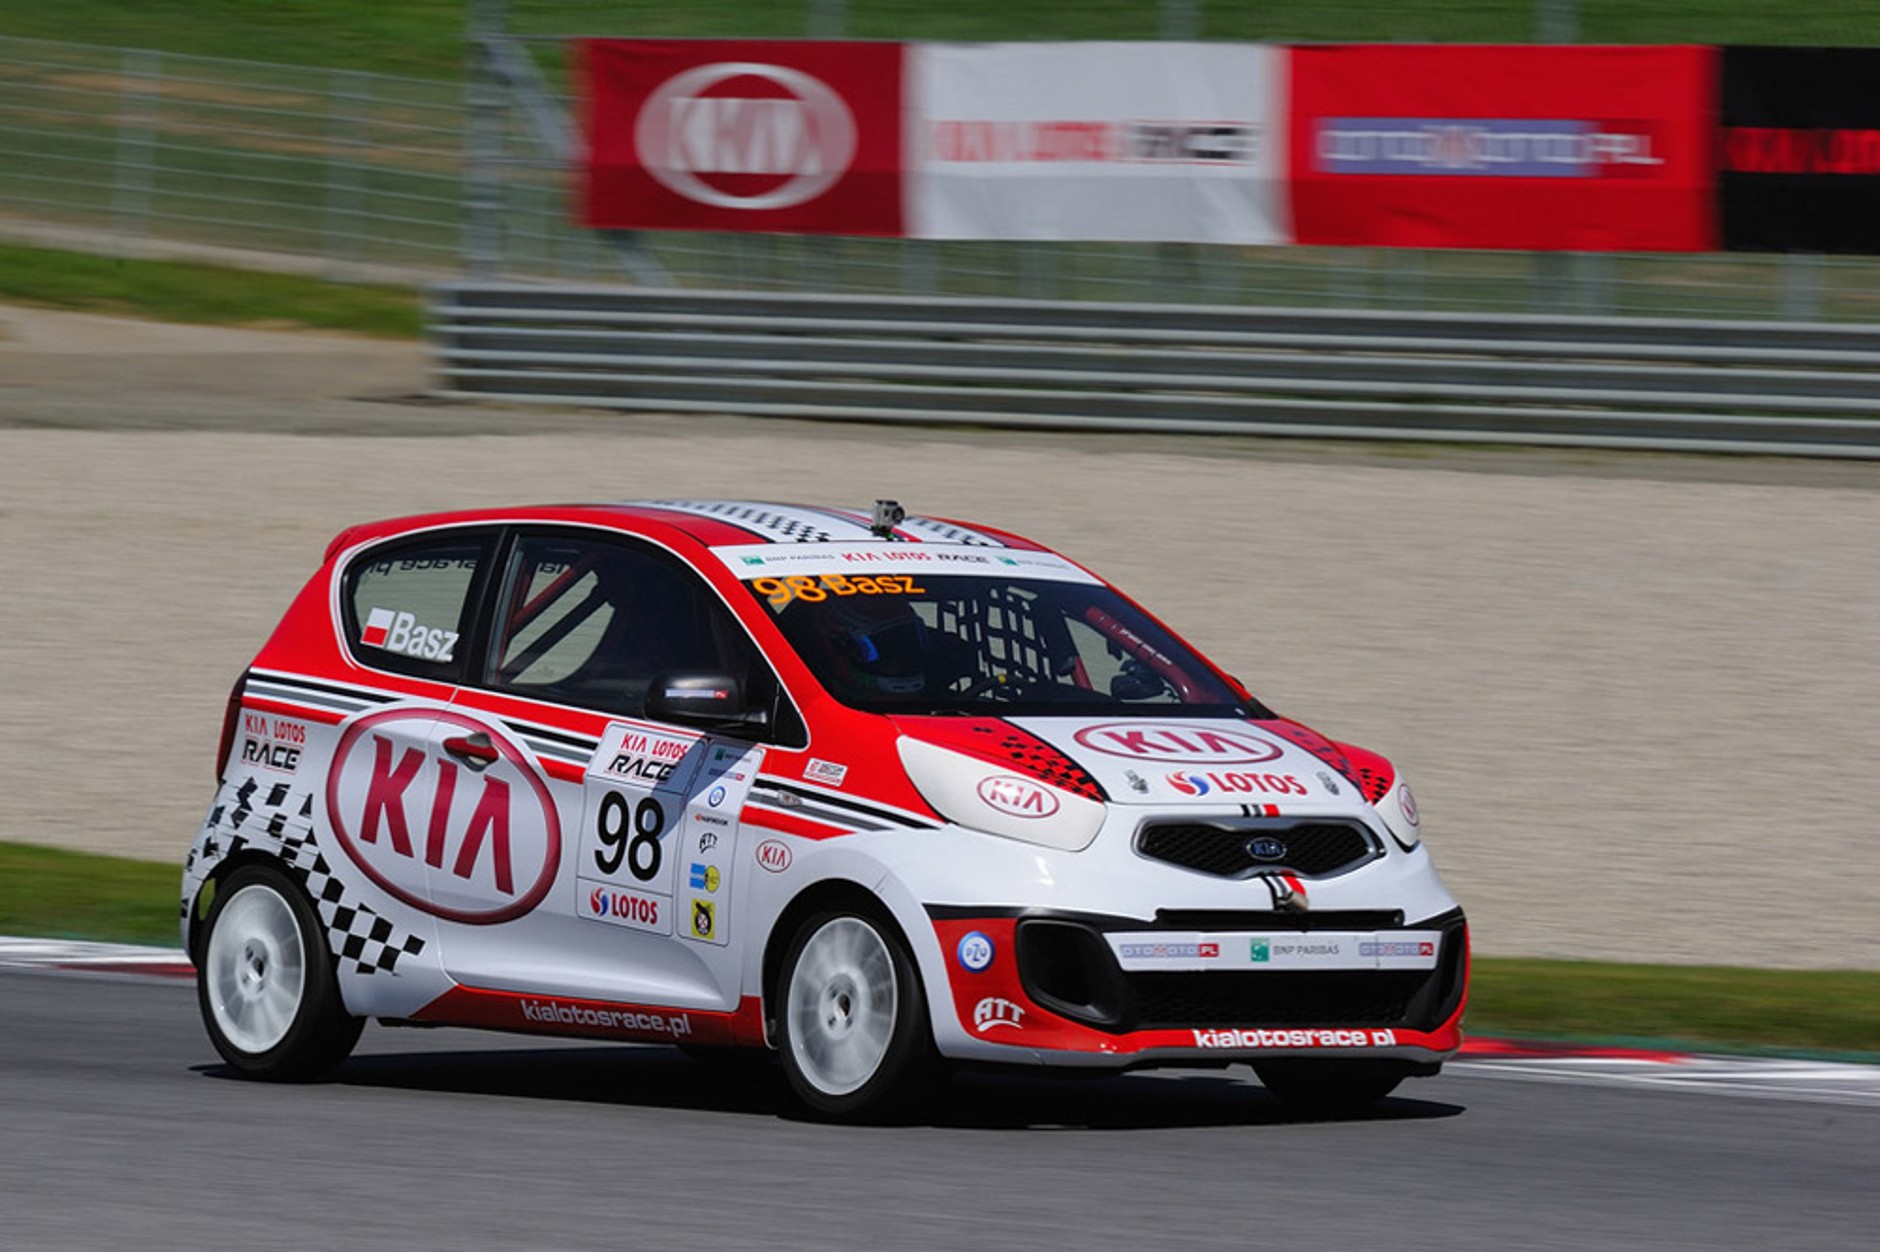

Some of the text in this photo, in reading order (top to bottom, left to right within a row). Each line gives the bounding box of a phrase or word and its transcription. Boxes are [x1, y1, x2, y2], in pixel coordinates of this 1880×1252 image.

[667, 97, 824, 174] KIA
[752, 573, 926, 605] 98 Basz
[387, 611, 459, 662] Basz
[245, 713, 305, 744] KIA LOTOS
[1098, 731, 1262, 754] KIA
[242, 739, 301, 770] RACE
[621, 731, 688, 761] KIA LOTOS
[608, 753, 678, 782] RACE
[990, 780, 1043, 813] KIA
[1207, 772, 1308, 796] LOTOS
[359, 734, 515, 896] KIA
[594, 790, 665, 881] 98
[762, 845, 785, 868] KIA
[612, 892, 658, 925] LOTOS
[521, 1000, 692, 1037] kialotosrace.pl
[973, 997, 1025, 1026] ATT
